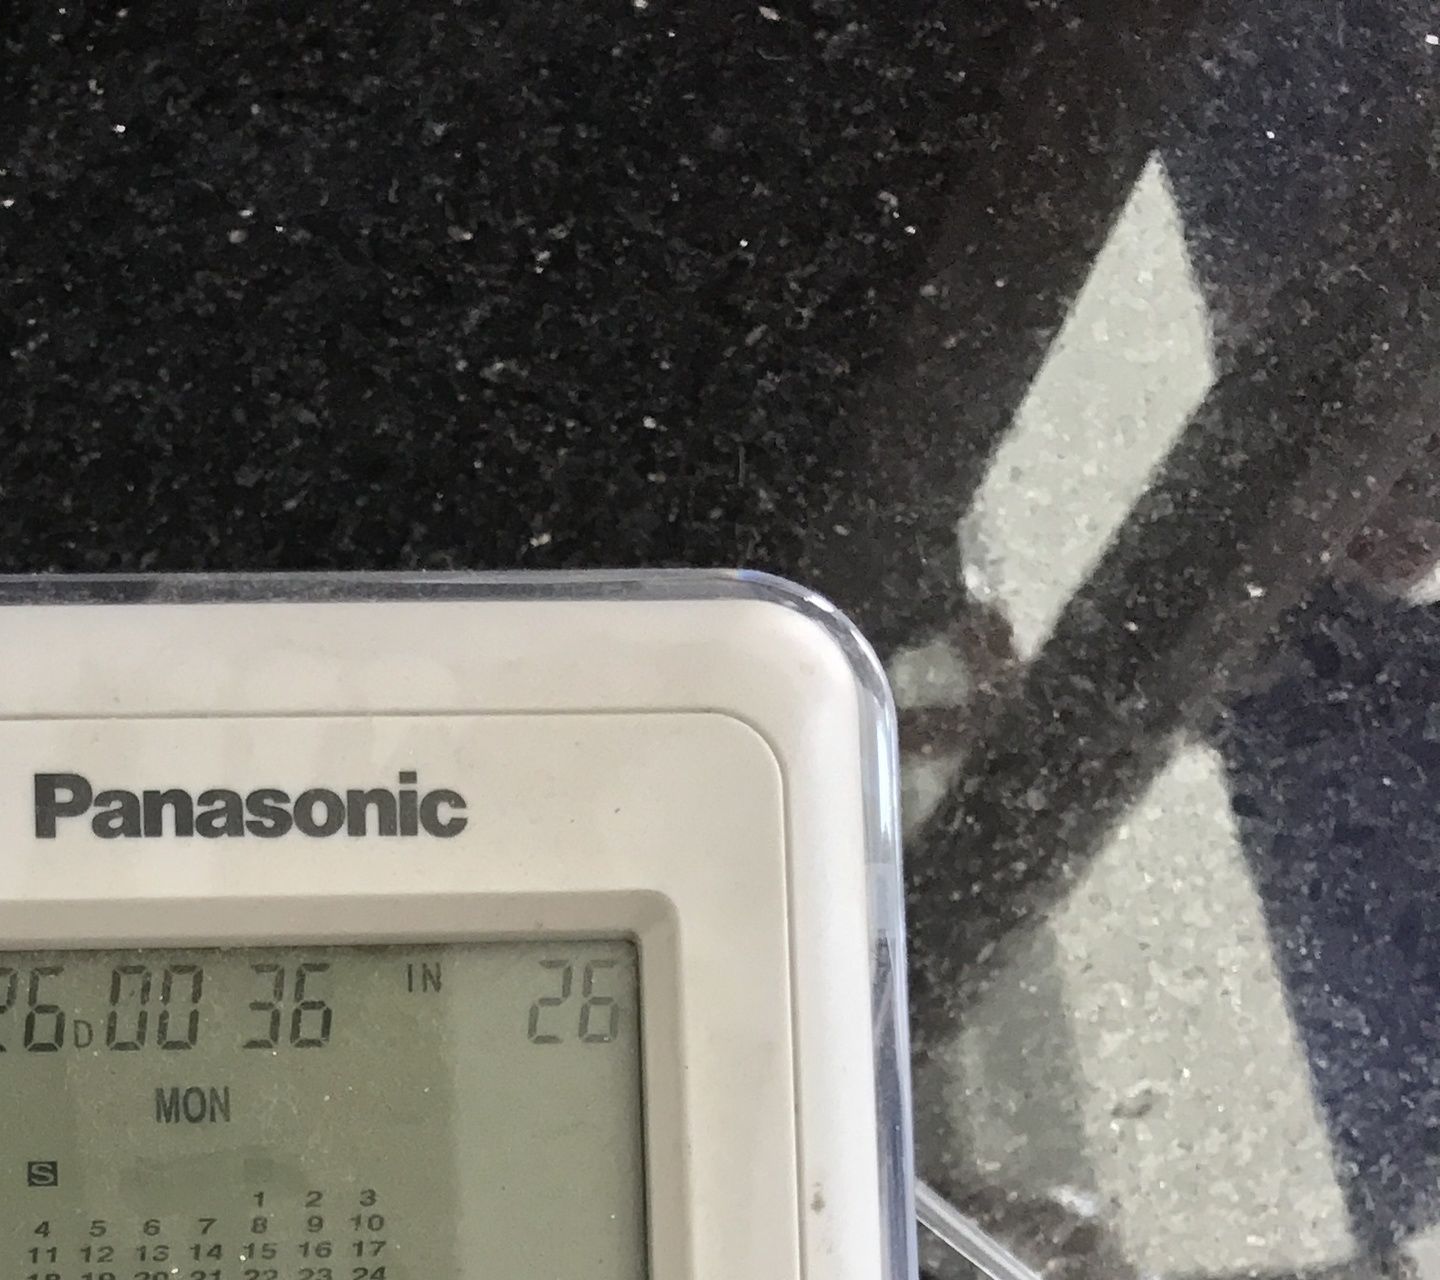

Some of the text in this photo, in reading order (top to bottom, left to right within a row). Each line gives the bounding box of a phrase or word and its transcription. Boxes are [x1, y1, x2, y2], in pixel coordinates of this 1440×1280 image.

[33, 771, 468, 839] Panasonic
[407, 962, 442, 993] IN
[242, 963, 332, 1049] 36
[526, 960, 621, 1044] 26
[155, 1086, 231, 1124] MON
[28, 1161, 58, 1187] S
[253, 1189, 377, 1207] 1 2 3
[34, 1214, 385, 1237] 4 5 6 7 8 9 10
[28, 1246, 59, 1264] 11
[81, 1245, 113, 1263] 12
[189, 1244, 223, 1261] 14
[242, 1243, 276, 1260] 15
[298, 1241, 331, 1259] 16
[352, 1241, 386, 1258] 17
